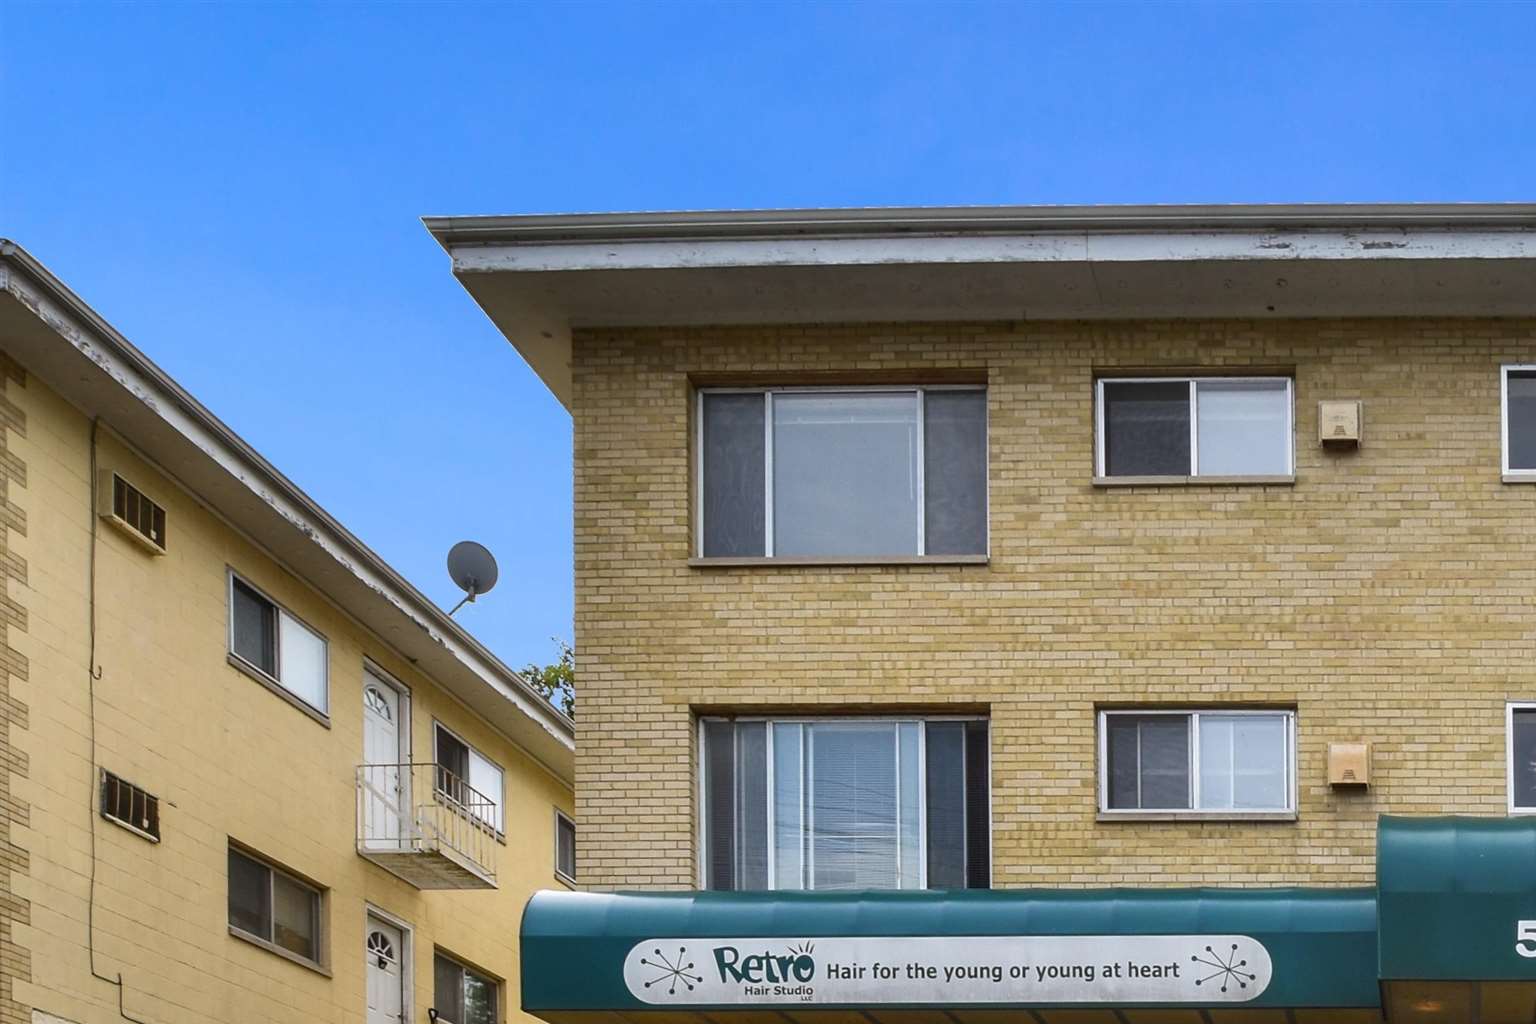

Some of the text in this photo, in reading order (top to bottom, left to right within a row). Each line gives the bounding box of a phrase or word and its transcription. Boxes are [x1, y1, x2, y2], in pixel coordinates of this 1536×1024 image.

[712, 945, 815, 984] Retro
[827, 961, 1180, 983] Hair for the young or young at heart
[744, 985, 814, 996] Hair Studio
